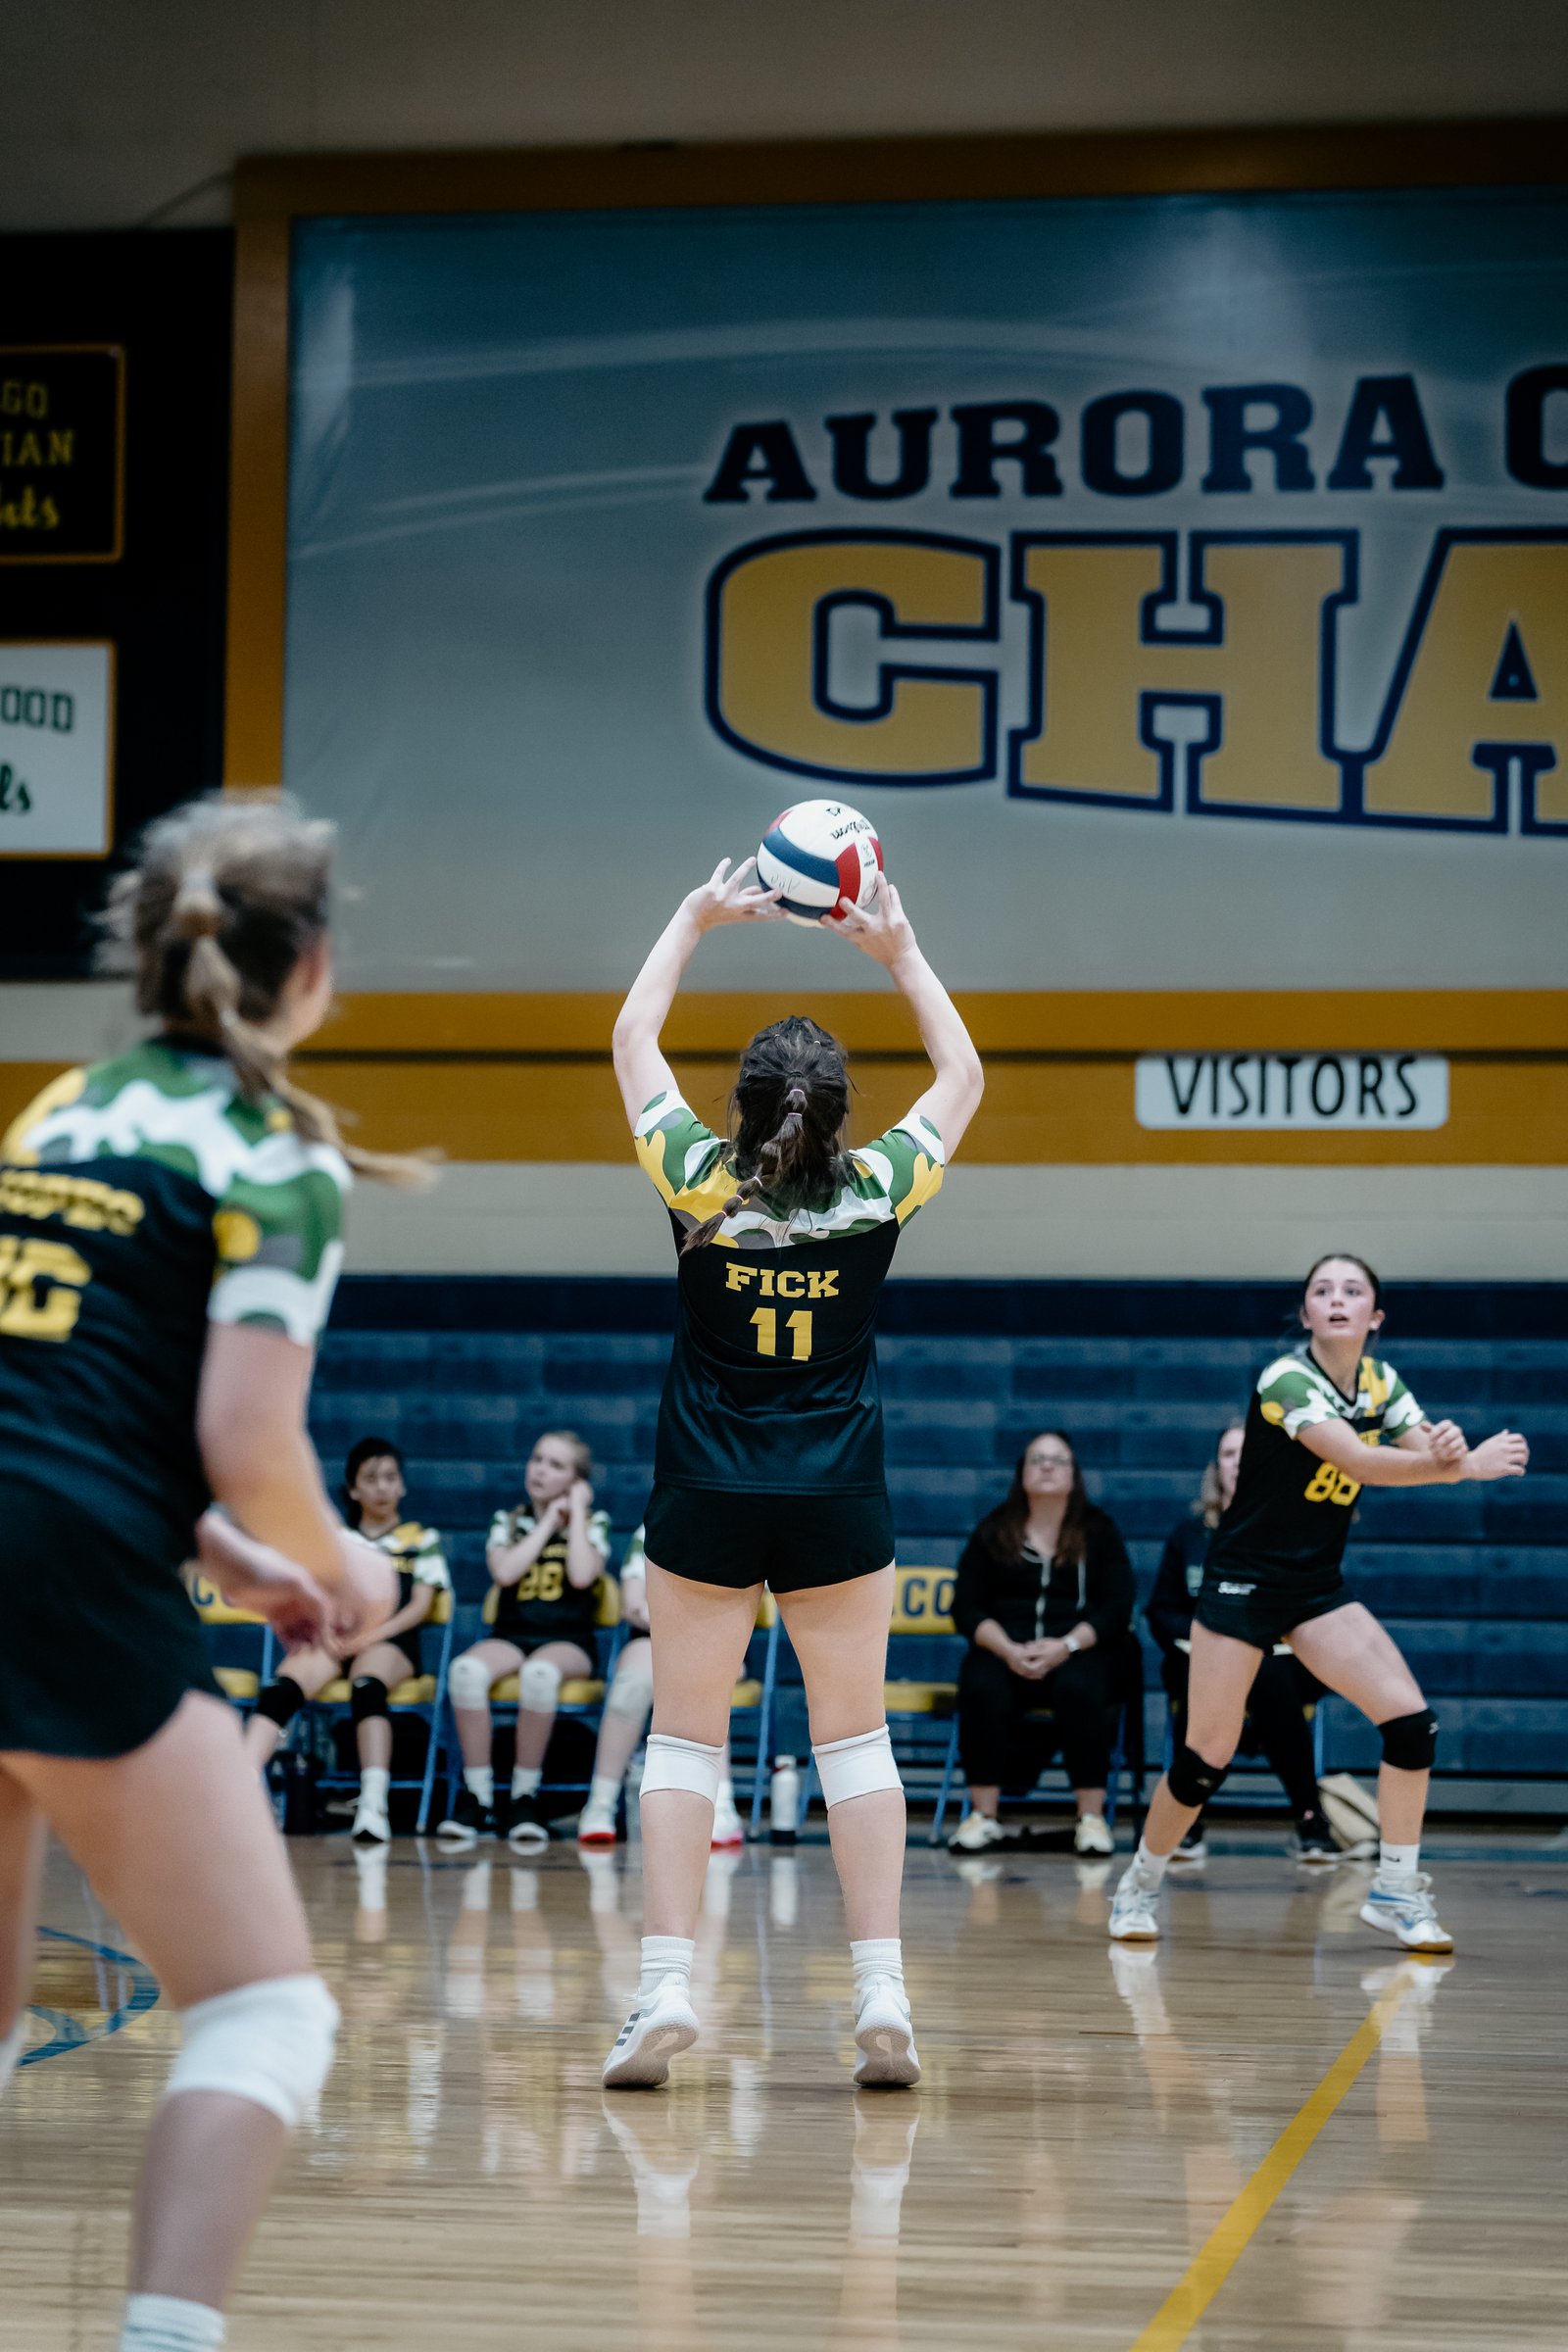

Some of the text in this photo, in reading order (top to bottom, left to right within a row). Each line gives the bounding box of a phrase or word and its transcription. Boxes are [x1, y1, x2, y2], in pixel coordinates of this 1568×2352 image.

[703, 373, 1446, 503] AURORA
[704, 525, 1568, 836] CHA
[1165, 1055, 1417, 1116] VISITORS
[724, 1261, 841, 1299] FICK
[749, 1306, 813, 1362] 11
